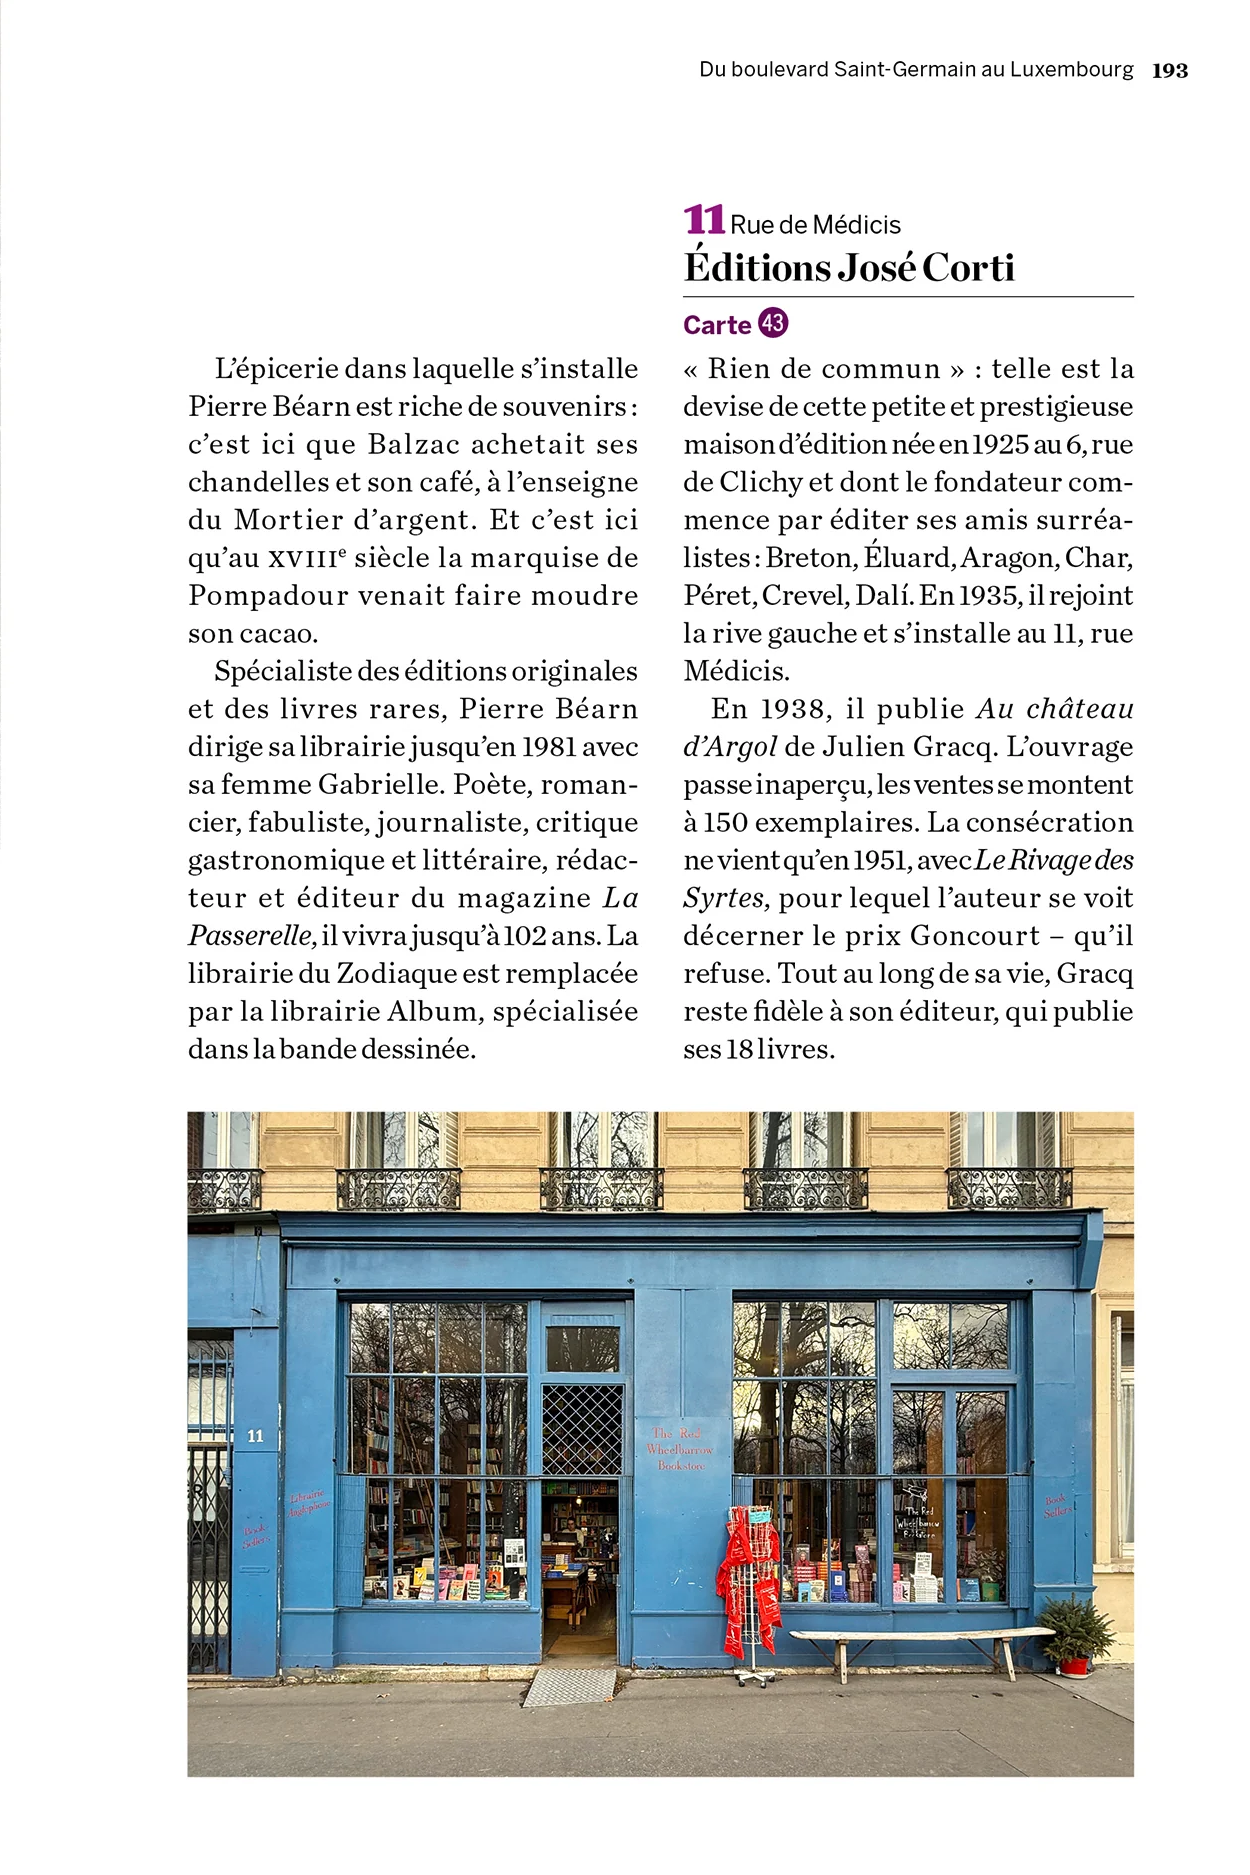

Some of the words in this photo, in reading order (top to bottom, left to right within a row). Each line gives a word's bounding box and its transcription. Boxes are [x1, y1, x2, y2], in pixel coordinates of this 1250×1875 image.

[701, 61, 725, 77] Du
[732, 61, 828, 77] boulevard
[835, 61, 975, 77] Saint-Germain
[982, 65, 1004, 77] au
[1011, 61, 1134, 81] Luxembourg
[1153, 63, 1188, 78] 193
[684, 204, 726, 234] 11
[732, 214, 774, 234] Rue
[780, 214, 807, 234] de
[814, 214, 901, 234] Médicis
[684, 241, 831, 282] Éditions
[838, 250, 916, 282] José
[923, 252, 1015, 282] Corti
[684, 315, 752, 335] Carte
[761, 313, 785, 333] 43
[262, 432, 295, 454] ici
[307, 440, 355, 460] que
[368, 433, 459, 454] Balzac
[472, 432, 585, 454] achetait
[597, 440, 637, 454] ses
[684, 515, 769, 530] mence
[778, 515, 822, 536] par
[830, 507, 909, 530] éditer
[917, 515, 956, 530] ses
[965, 508, 1027, 530] amis
[1037, 507, 1133, 530] surréa-
[189, 584, 348, 611] Pompadour
[358, 584, 445, 605] venait
[455, 583, 521, 605] faire
[532, 584, 638, 605] moudre
[189, 629, 233, 643] son
[240, 629, 317, 643] cacao.
[684, 659, 789, 681] Médicis.
[785, 735, 815, 756] de
[823, 735, 905, 757] Julien
[914, 735, 998, 763] Gracq.
[189, 810, 241, 836] cier,
[249, 810, 370, 836] fabuliste,
[375, 810, 528, 838] journaliste,
[537, 810, 638, 838] critique
[683, 886, 770, 914] Syrtes,
[779, 893, 842, 914] pour
[850, 886, 930, 914] lequel
[1049, 893, 1075, 908] se
[1084, 886, 1133, 908] voit
[189, 1007, 233, 1027] par
[240, 1000, 264, 1021] la
[271, 999, 380, 1021] librairie
[387, 1000, 484, 1025] Album,
[494, 999, 638, 1027] spécialisée
[684, 1044, 721, 1059] ses
[727, 1039, 753, 1059] 18
[758, 1037, 835, 1059] livres.
[247, 1429, 264, 1443] 11
[652, 1427, 673, 1439] The
[680, 1427, 701, 1439] Red
[646, 1443, 713, 1455] Wheelbarrow
[658, 1459, 706, 1471] Bookstore
[289, 1488, 325, 1504] Librairie
[287, 1500, 331, 1519] Anglophone
[905, 1506, 919, 1516] The
[921, 1506, 934, 1516] Red
[1043, 1506, 1073, 1520] Sellers
[242, 1536, 271, 1550] Sellers
